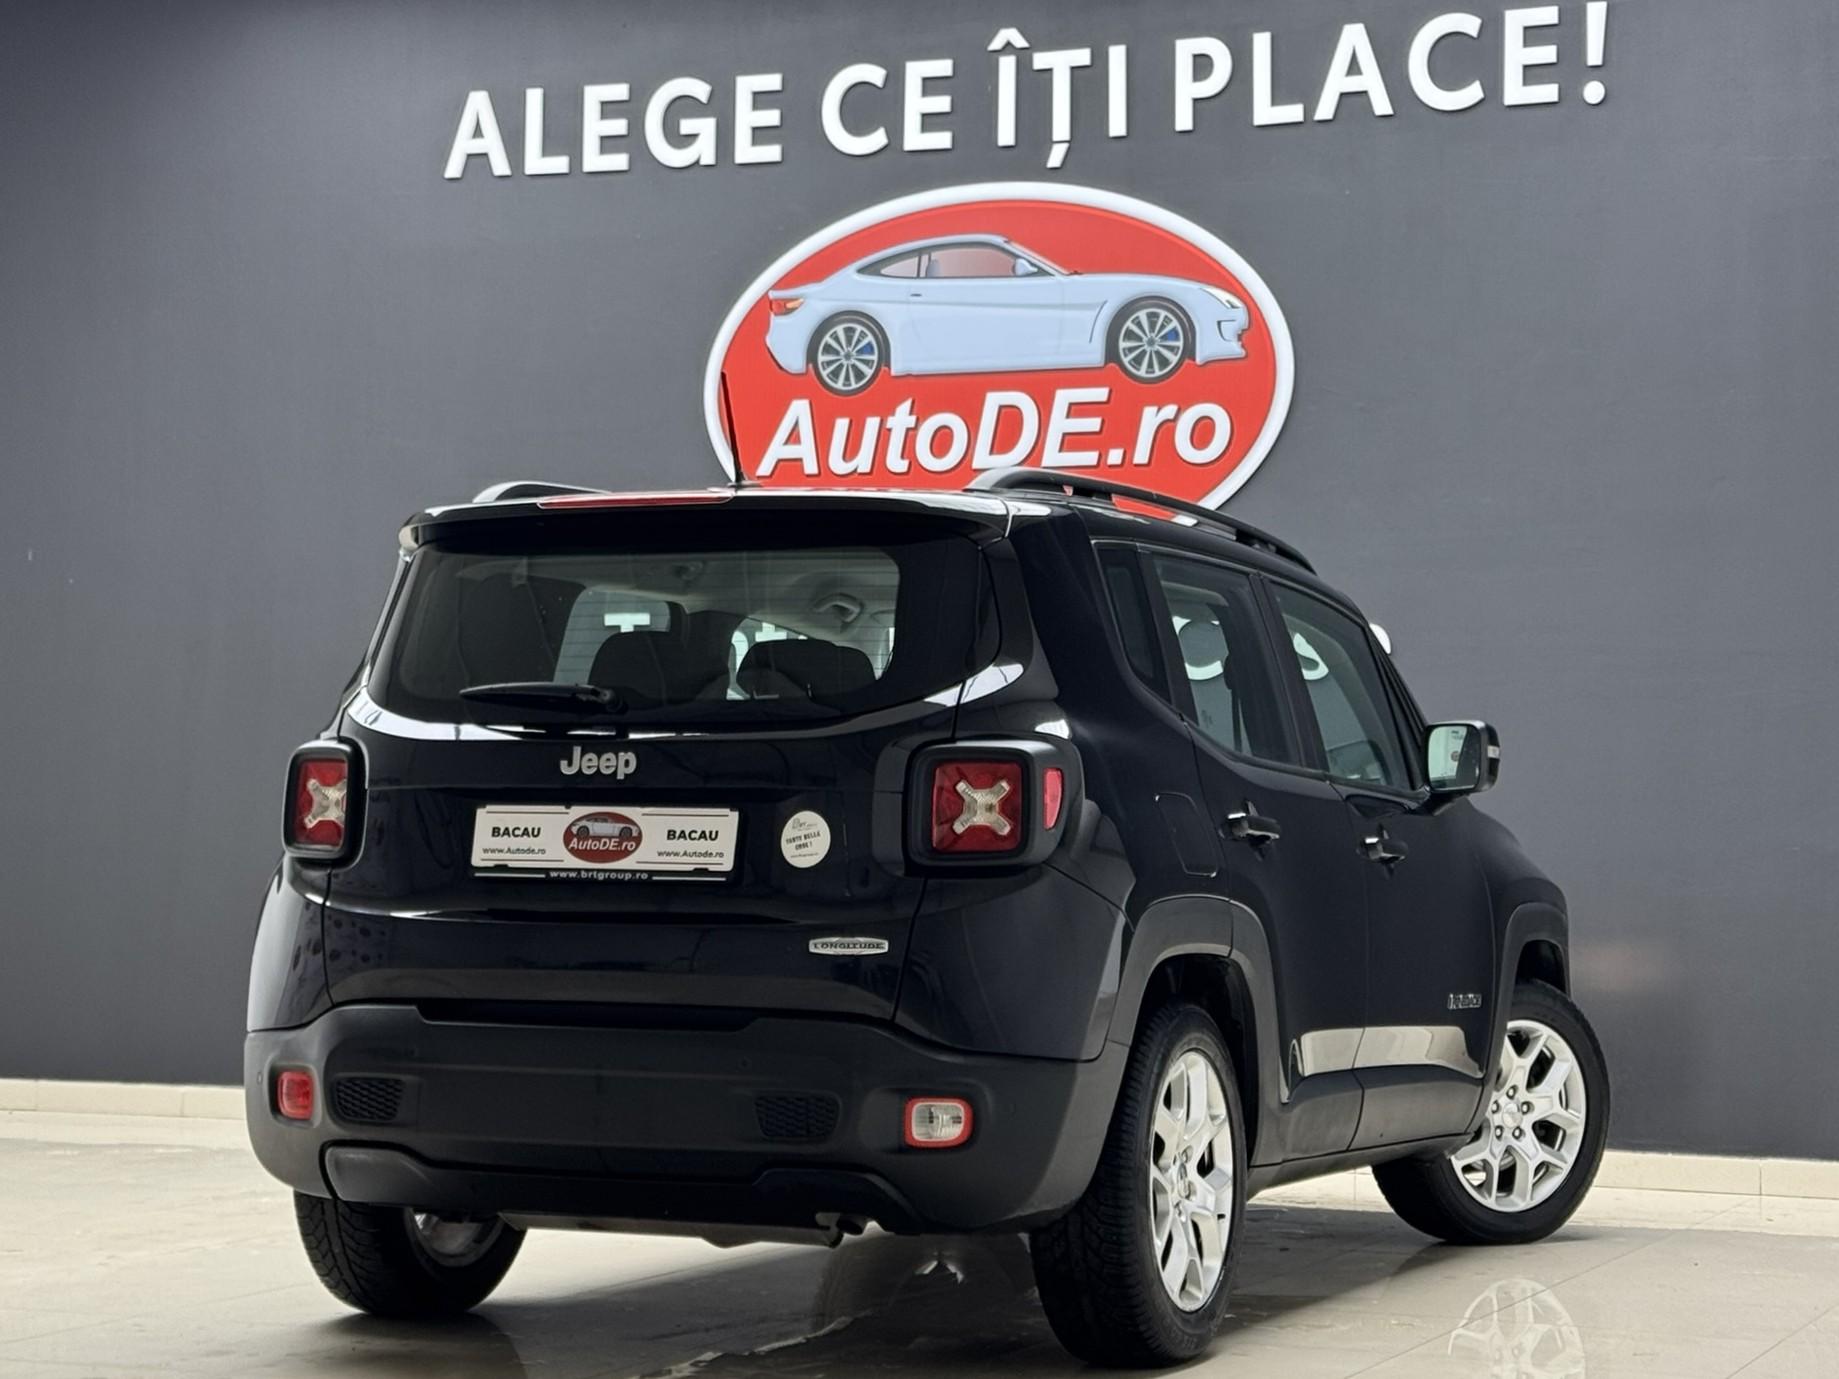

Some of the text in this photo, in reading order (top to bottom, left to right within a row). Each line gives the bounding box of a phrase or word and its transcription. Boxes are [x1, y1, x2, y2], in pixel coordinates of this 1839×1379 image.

[443, 1, 1609, 180] ALEGE CE ÎȚI PLACE!
[756, 387, 1232, 477] AutoDE.ro
[560, 745, 637, 780] Jeep
[491, 826, 542, 839] BACAU
[666, 828, 719, 842] BACAU
[482, 846, 547, 856] www.Autode.ro
[568, 837, 637, 852] AutoDE.ro
[656, 849, 725, 860] www.Autode.ro
[813, 942, 886, 950] LONGITUDE
